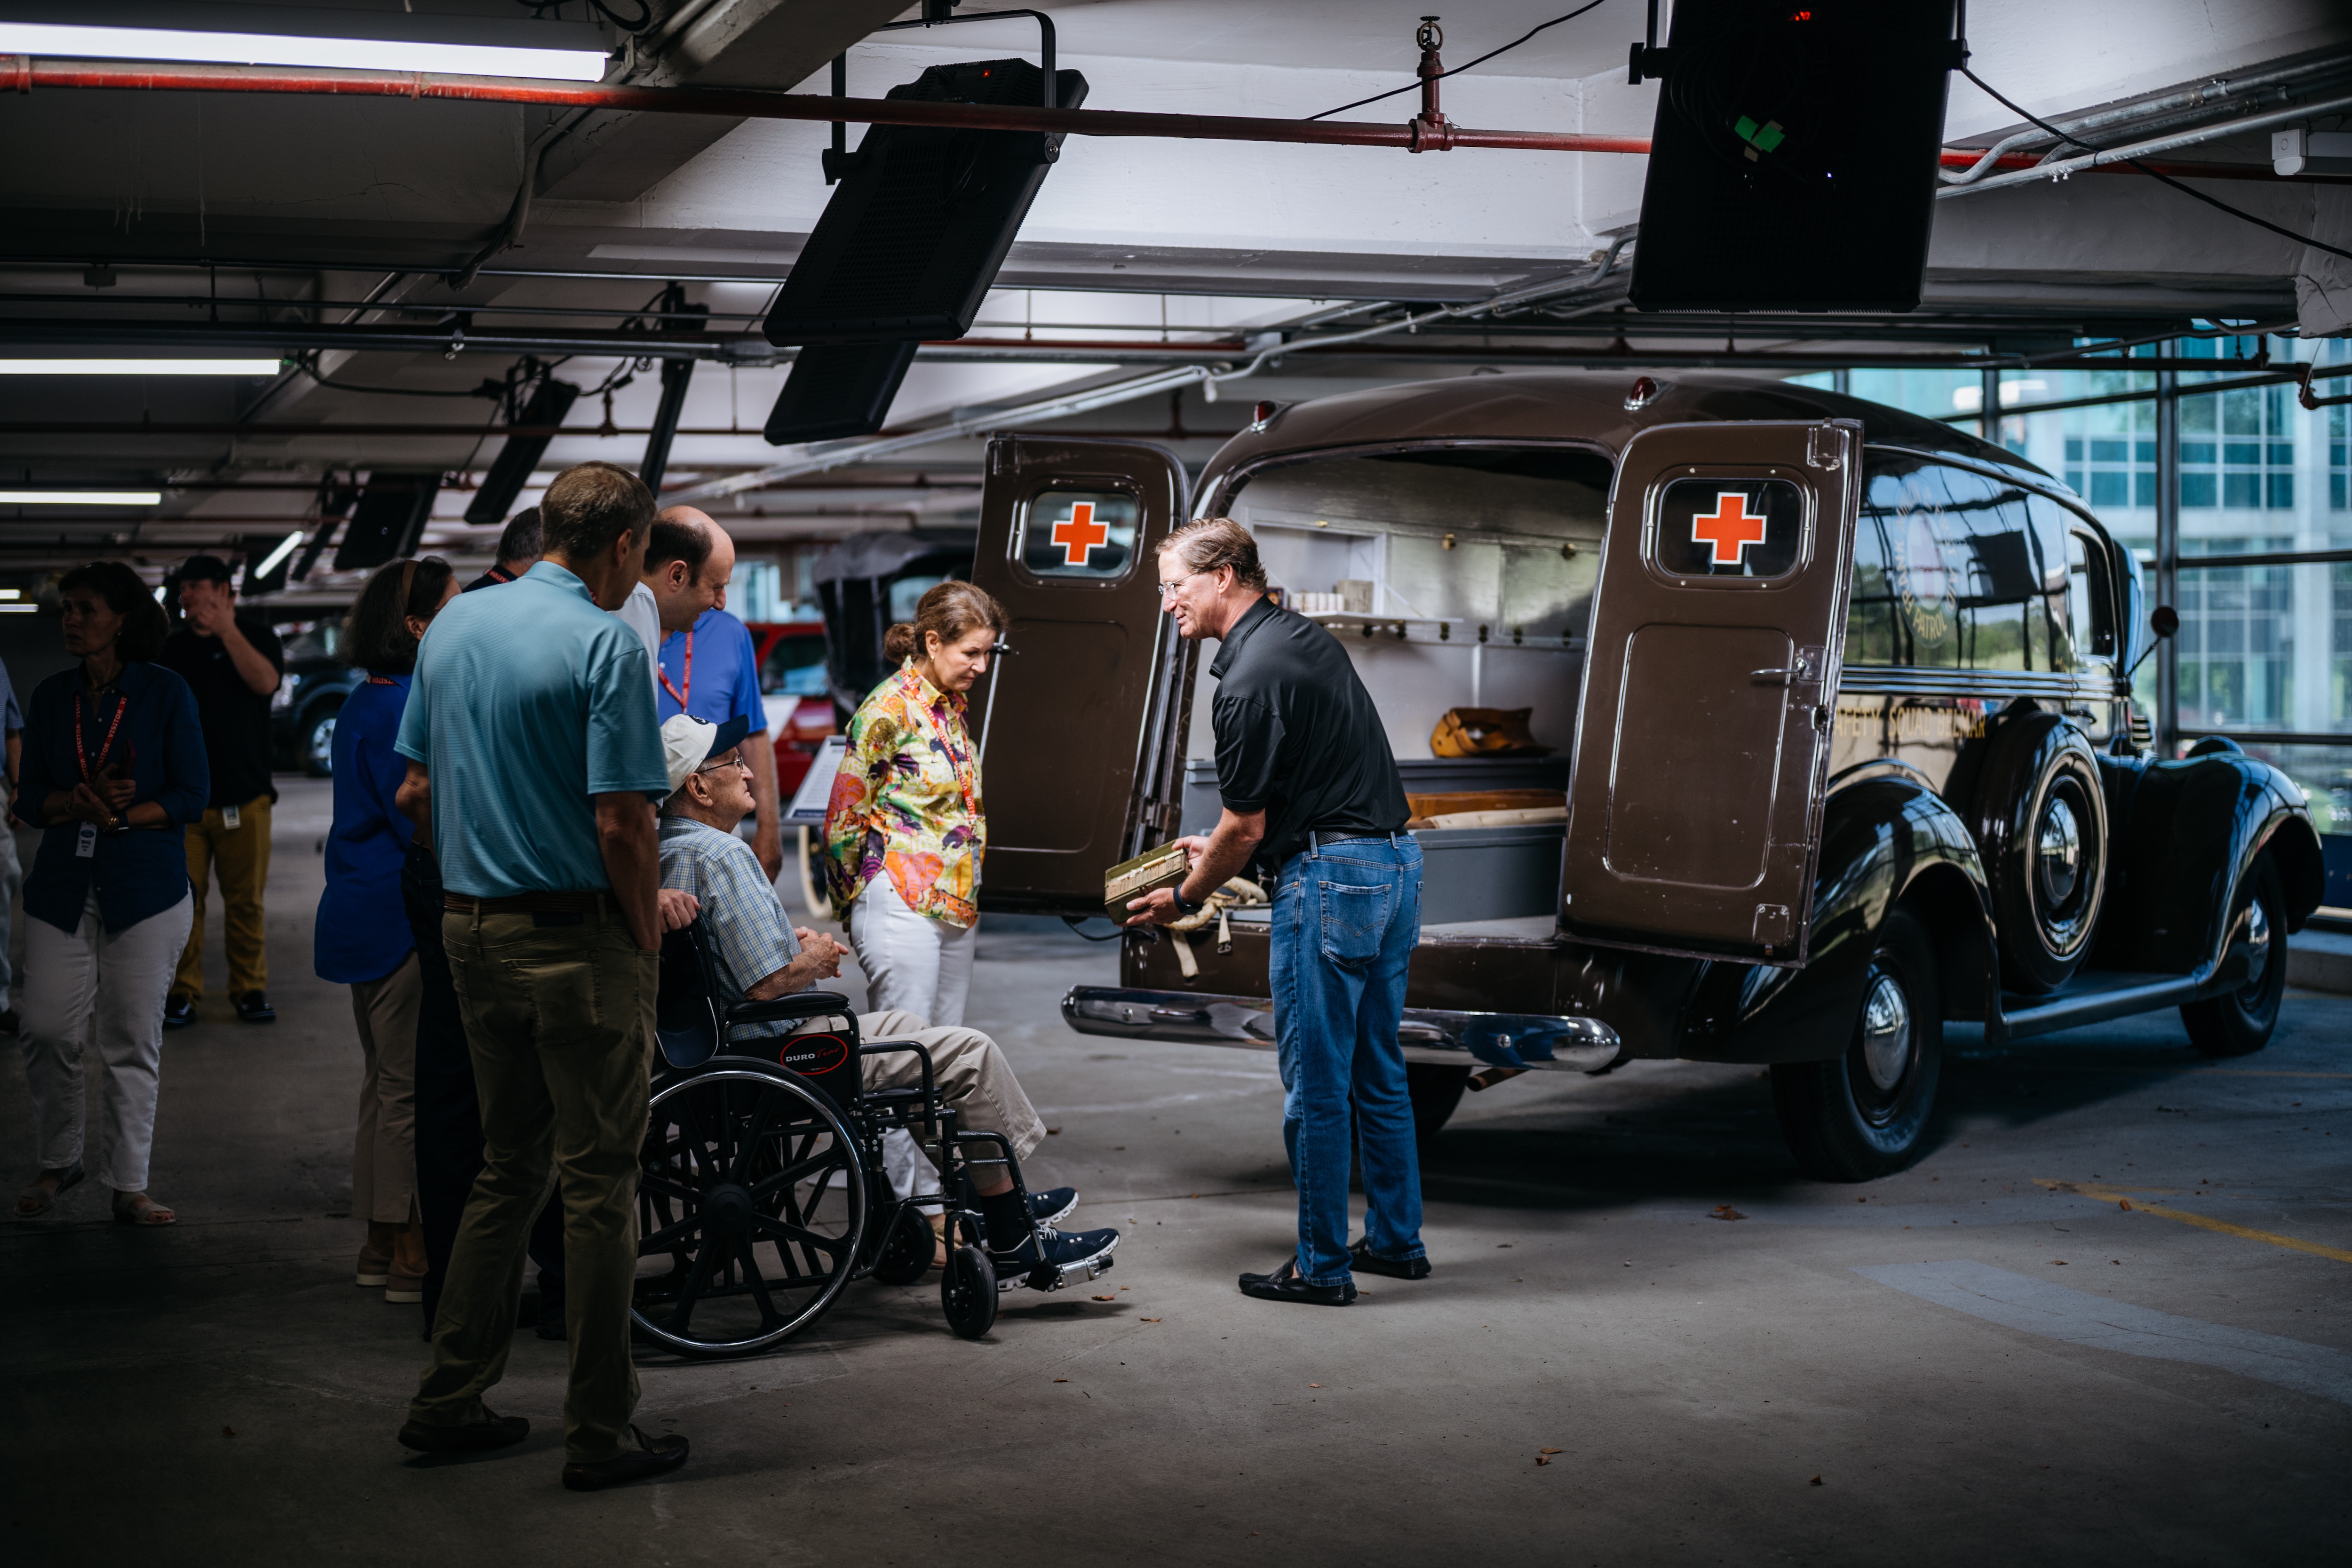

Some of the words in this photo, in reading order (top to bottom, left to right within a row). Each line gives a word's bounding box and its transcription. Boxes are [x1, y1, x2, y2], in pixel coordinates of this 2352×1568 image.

[916, 692, 936, 723] VISITOR
[108, 709, 123, 738] VISITOR
[1835, 708, 1881, 737] AFETY
[1888, 707, 1931, 740] SQUAD
[1937, 708, 1986, 738] BELMAR
[936, 727, 954, 756] VISITOR
[95, 742, 110, 772] VISITOR
[786, 1053, 815, 1062] DURO
